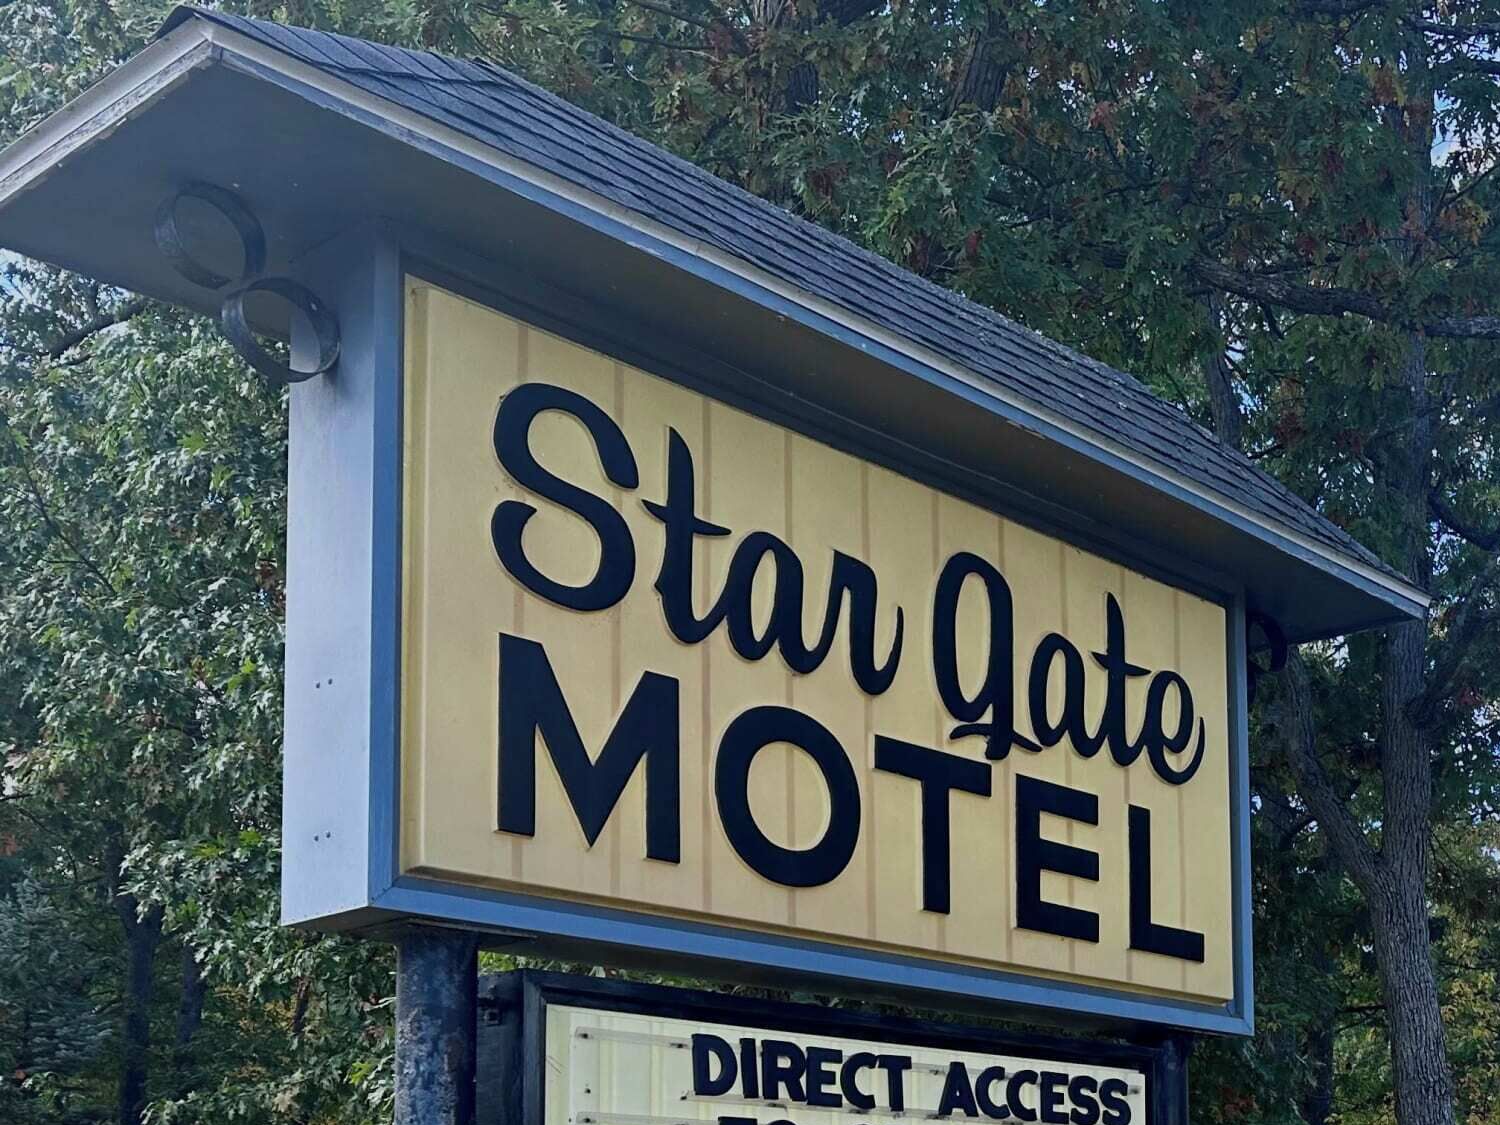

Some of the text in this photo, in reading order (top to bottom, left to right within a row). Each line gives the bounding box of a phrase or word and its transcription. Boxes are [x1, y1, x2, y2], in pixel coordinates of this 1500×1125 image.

[491, 382, 903, 695] Star
[496, 633, 1205, 963] MOTEL
[691, 1033, 912, 1112] DIRECT
